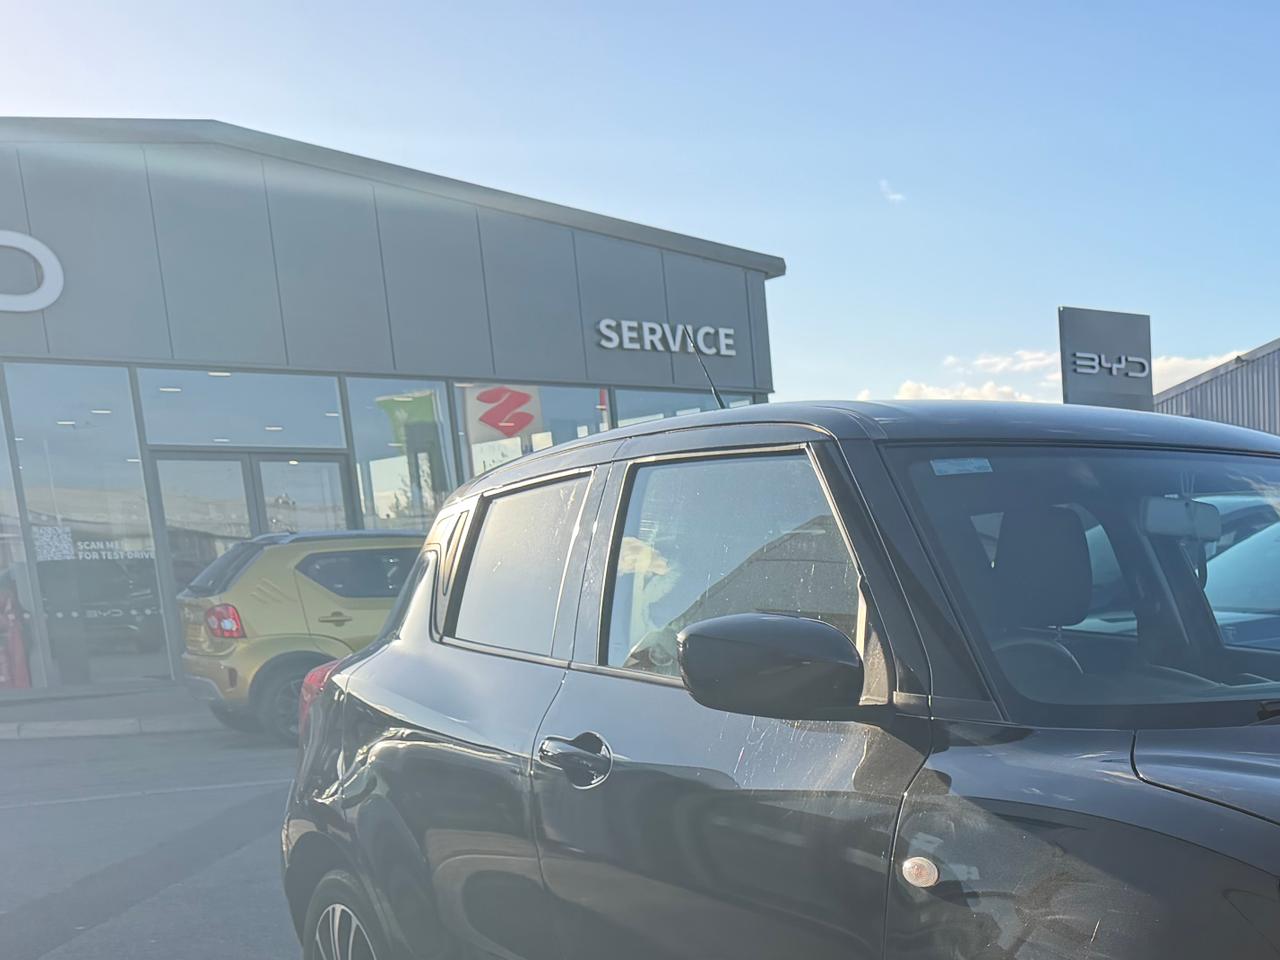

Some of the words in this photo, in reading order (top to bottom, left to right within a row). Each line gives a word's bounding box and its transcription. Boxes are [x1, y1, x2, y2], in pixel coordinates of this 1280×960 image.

[597, 318, 736, 357] SERVICE
[1073, 351, 1149, 378] BYD
[77, 541, 105, 551] SCAN
[79, 551, 100, 560] FOR
[101, 551, 124, 560] TEST
[127, 551, 155, 559] DRIVE
